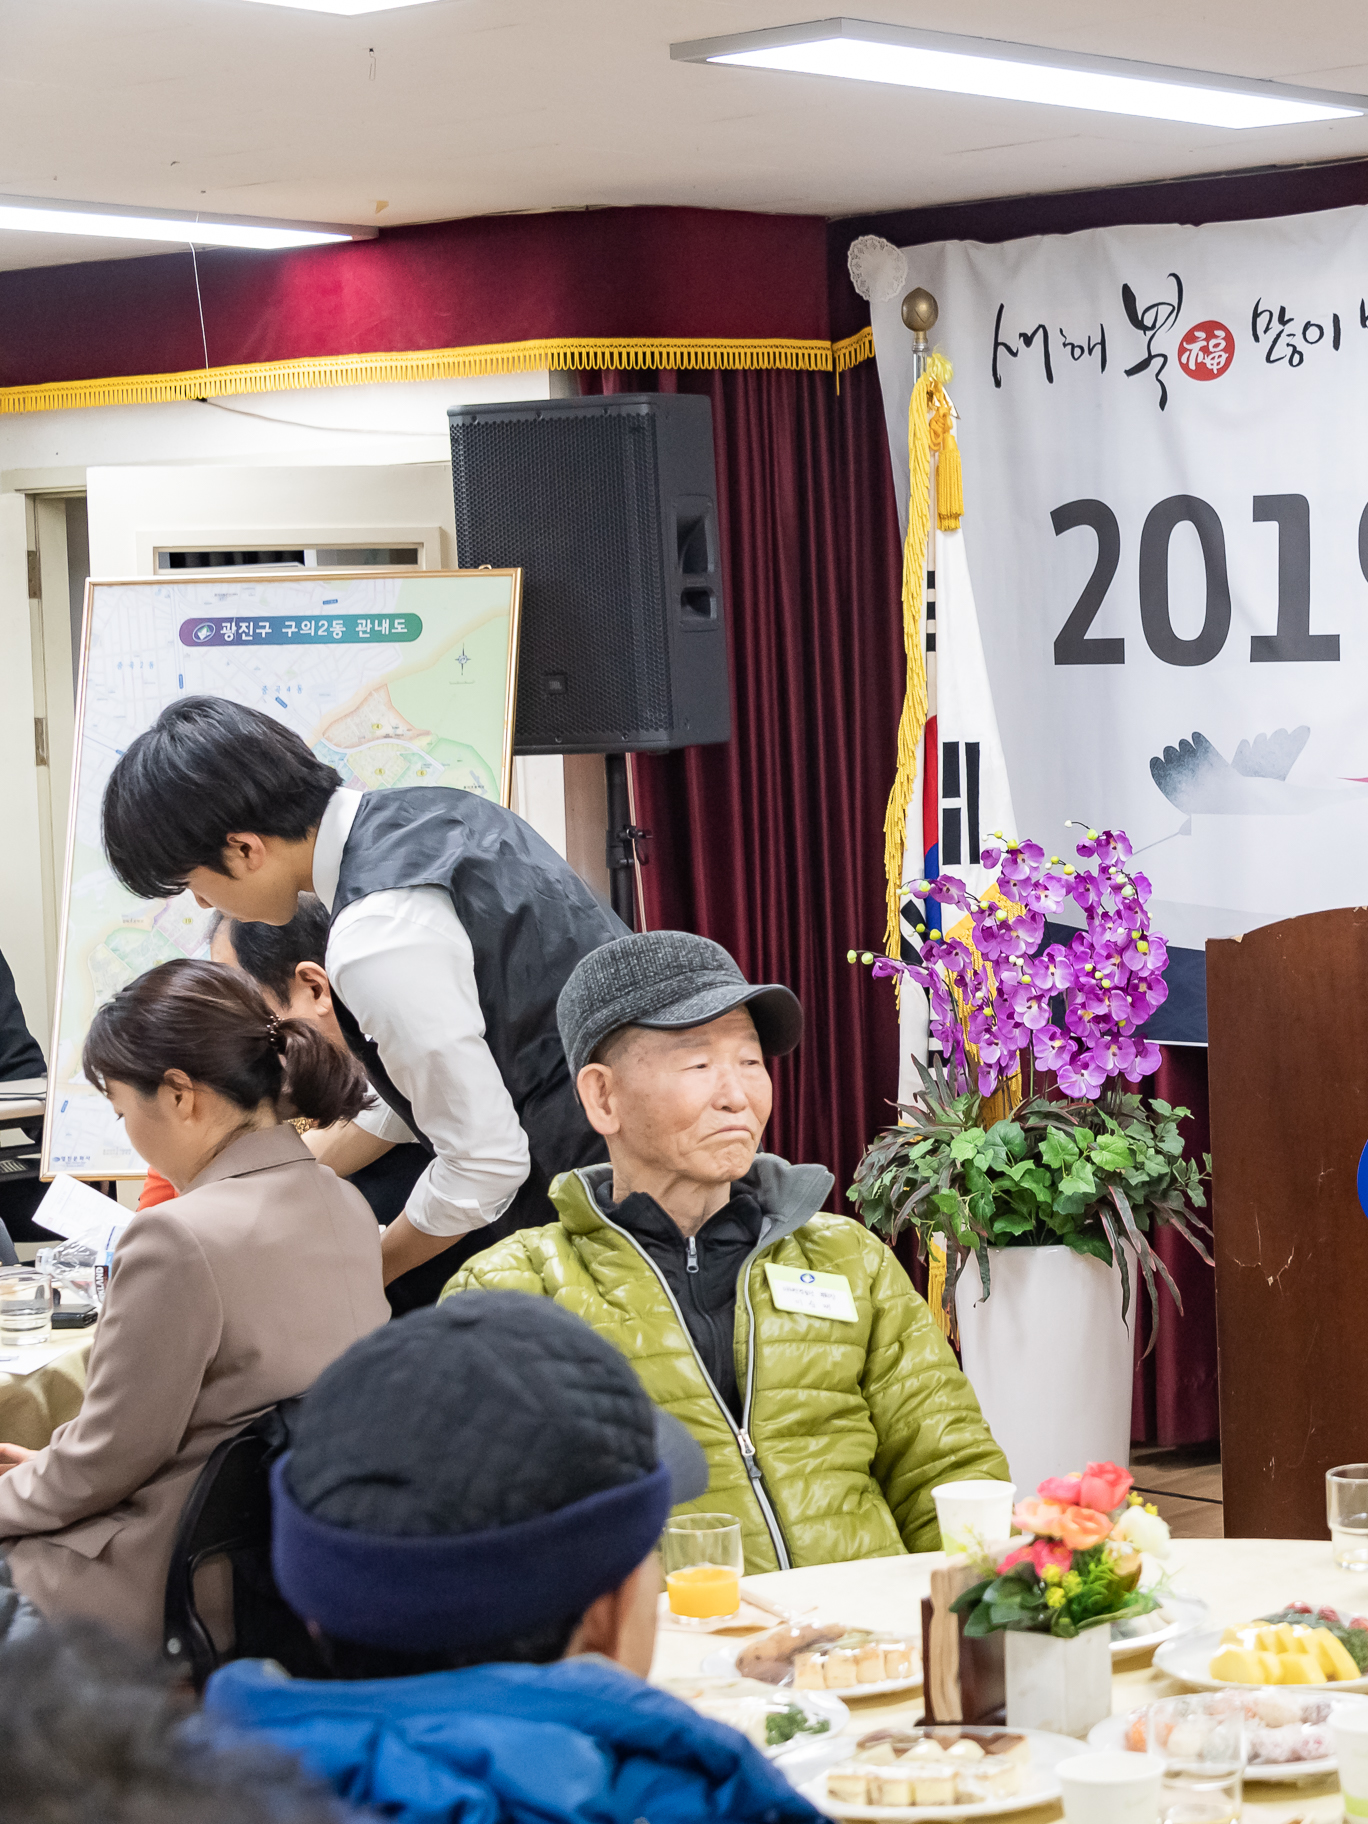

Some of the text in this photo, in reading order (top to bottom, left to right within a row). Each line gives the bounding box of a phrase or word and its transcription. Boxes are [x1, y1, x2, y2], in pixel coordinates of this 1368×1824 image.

[1122, 273, 1184, 411] 복
[1181, 329, 1229, 375] 福
[1251, 298, 1341, 367] 많이
[220, 619, 408, 641] 광진구 구의2동 관내도
